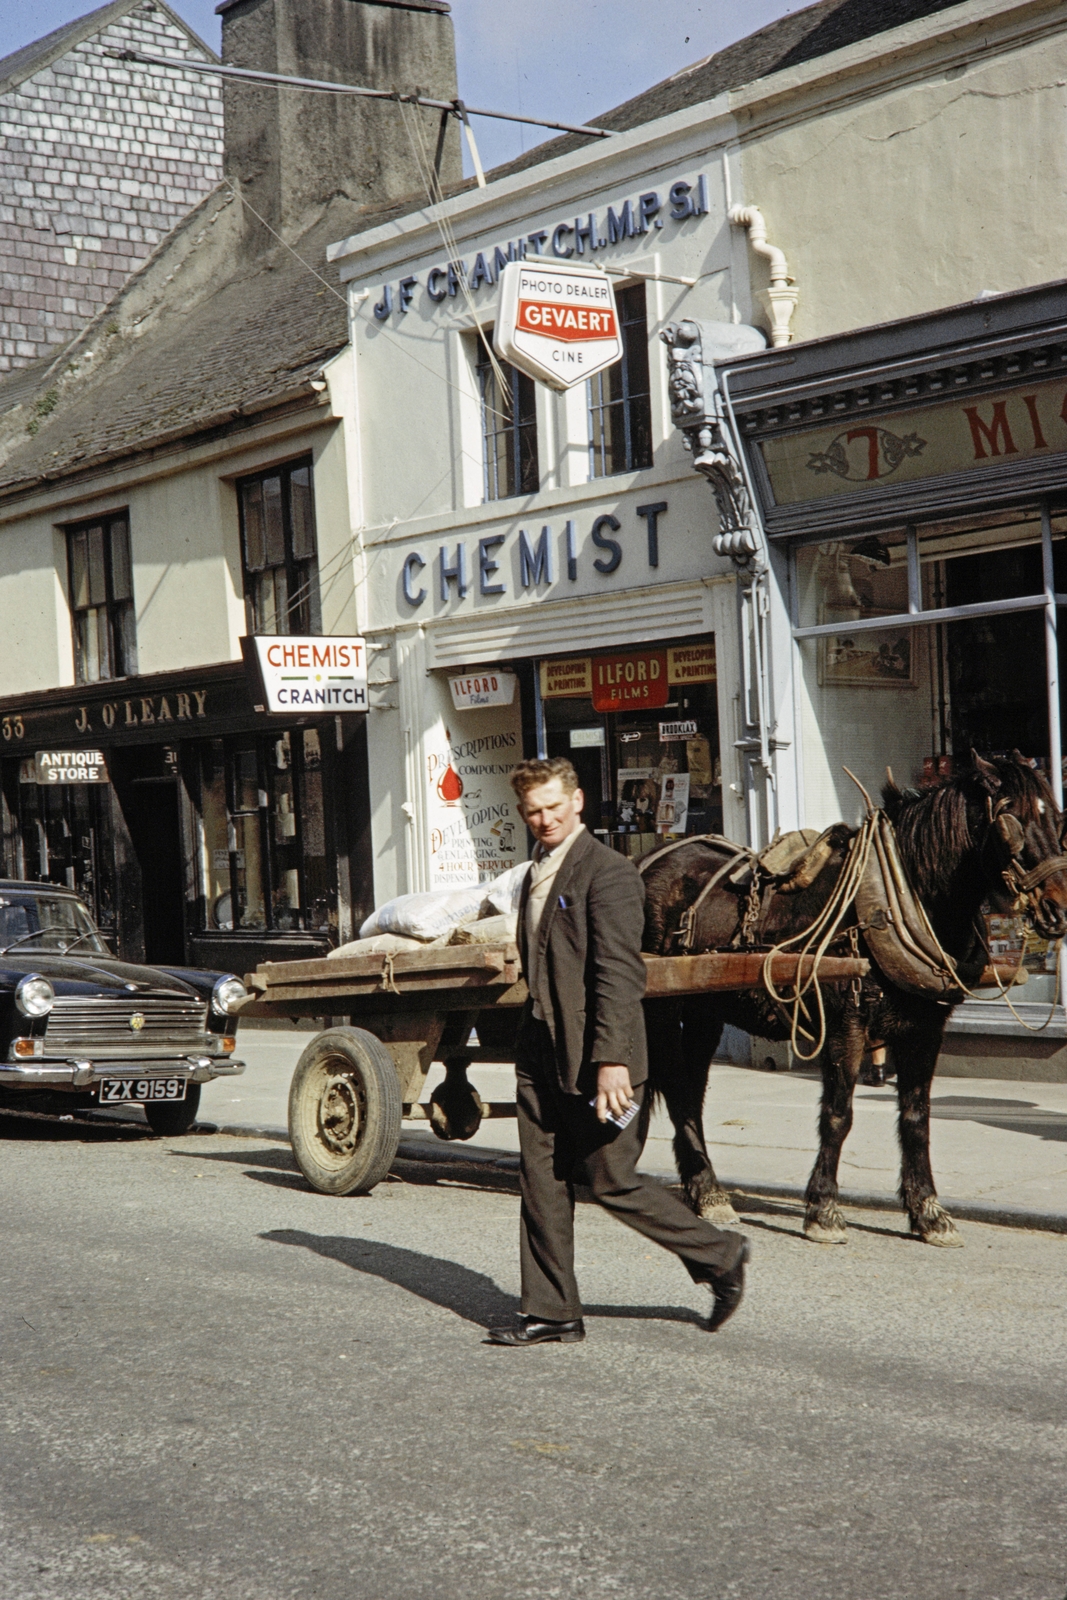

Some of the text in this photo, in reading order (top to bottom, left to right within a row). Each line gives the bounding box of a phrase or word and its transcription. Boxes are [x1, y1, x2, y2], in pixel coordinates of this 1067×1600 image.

[521, 279, 608, 299] PHOTO DEALER
[525, 305, 611, 332] GEVAERT
[552, 350, 583, 363] CINE
[847, 392, 1067, 480] 7 MI
[402, 501, 668, 607] CHEMIST
[267, 644, 363, 668] CHEMIST
[546, 662, 587, 678] DEVELOPING
[599, 659, 661, 686] ILFORD
[453, 676, 499, 696] ILFORD
[554, 677, 587, 691] PRINTING
[611, 685, 649, 700] FILMS
[277, 688, 365, 704] CRANITCH
[469, 694, 489, 704] Films
[2, 715, 25, 741] 33
[102, 690, 208, 730] O'LEARY
[40, 752, 105, 767] ANTIQUE
[427, 732, 517, 784] PRESCRIPTIONS
[48, 767, 99, 780] STORE
[430, 802, 509, 854] DEVELOPING
[451, 837, 493, 850] PRINTING
[446, 861, 475, 872] HOUR
[477, 859, 515, 871] SERVICE
[434, 873, 477, 884] DISPENSING
[107, 1079, 178, 1098] ZX 9159
